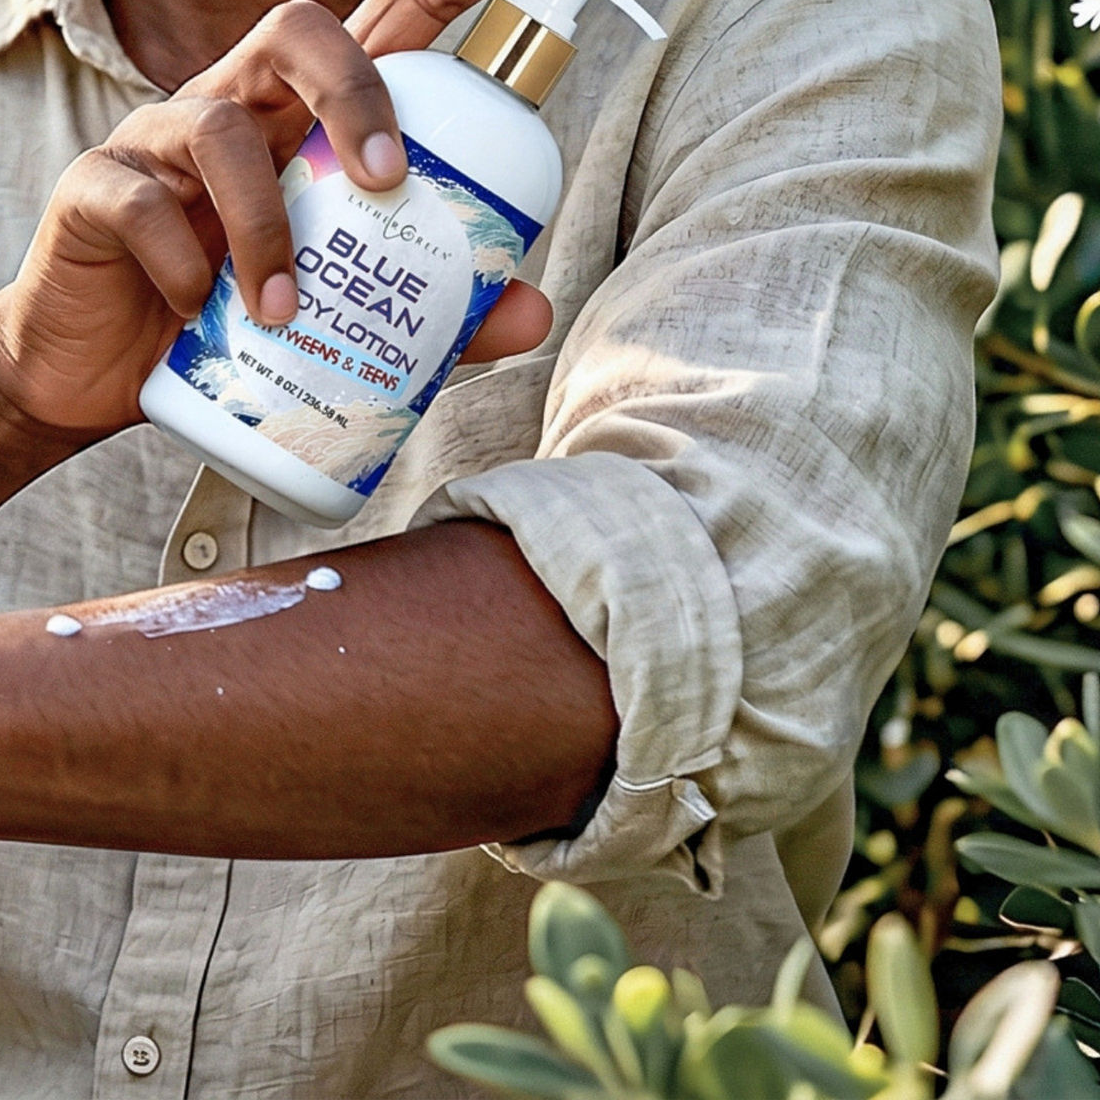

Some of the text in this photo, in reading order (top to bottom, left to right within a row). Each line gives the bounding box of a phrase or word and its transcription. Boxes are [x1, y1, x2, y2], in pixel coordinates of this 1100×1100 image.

[295, 246, 425, 337] OCEAN
[326, 227, 428, 304] BLUE
[297, 288, 418, 375] DY LOTION
[237, 351, 258, 368] NET
[256, 363, 274, 381] WT.
[275, 375, 284, 386] 8
[282, 381, 299, 395] OZ
[302, 392, 336, 419] 236.58
[335, 414, 349, 429] ML
[342, 357, 354, 371] &
[357, 361, 400, 391] TEENS
